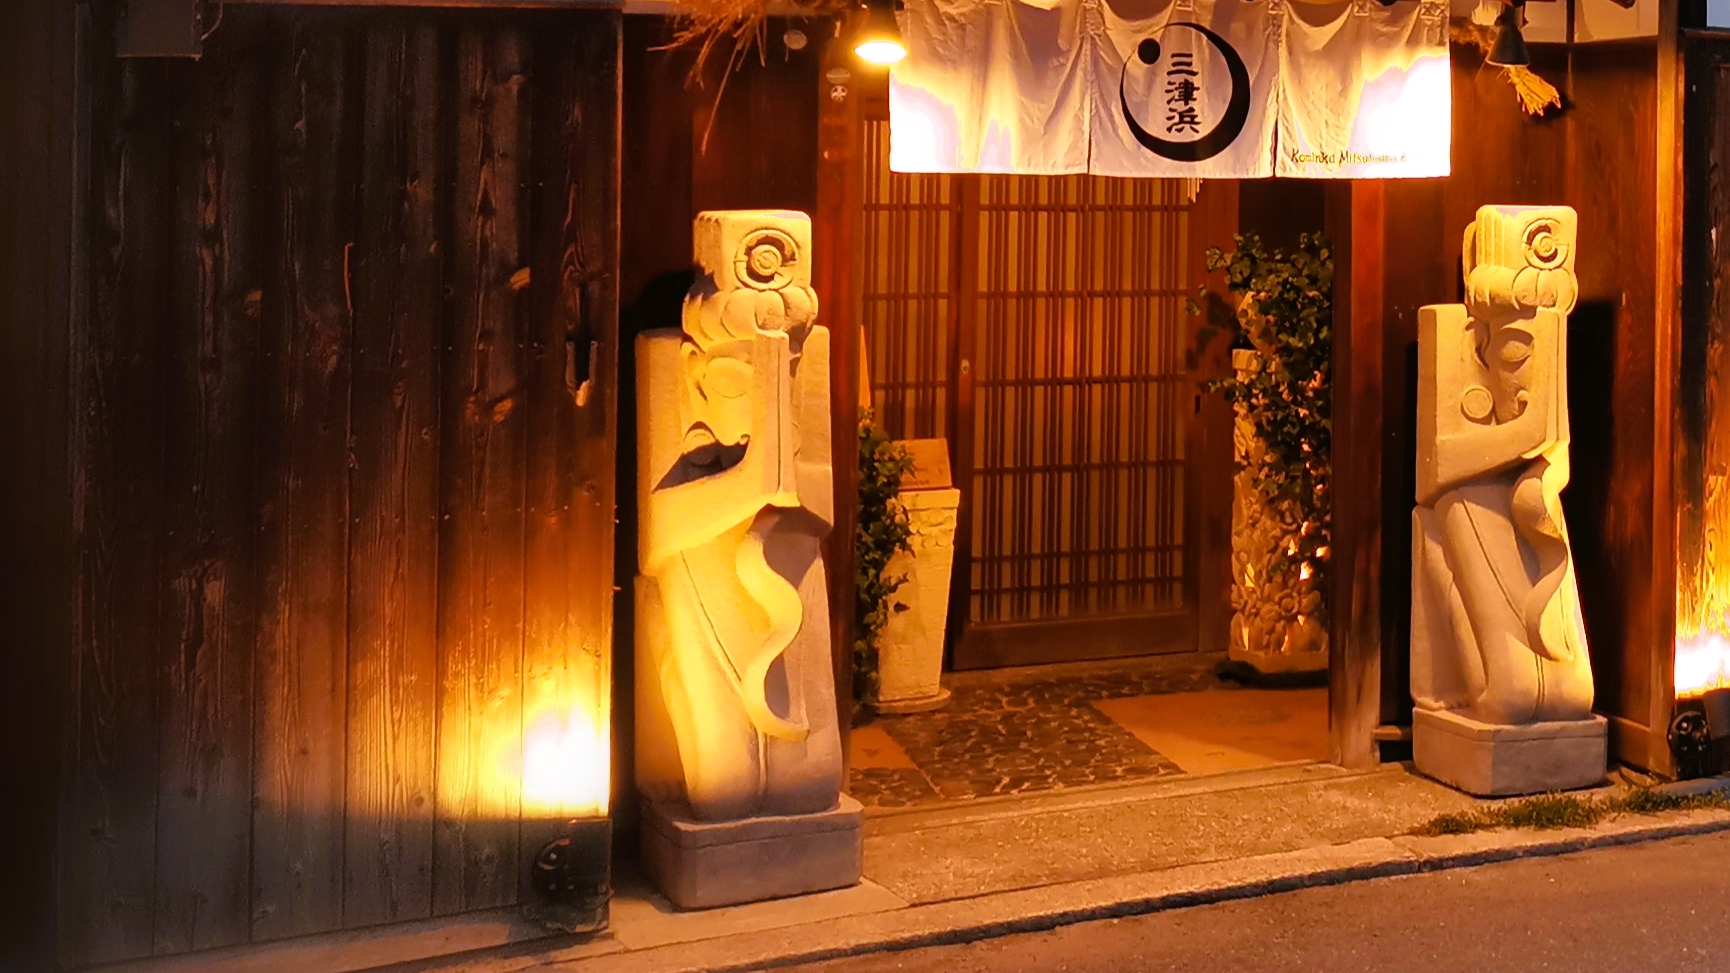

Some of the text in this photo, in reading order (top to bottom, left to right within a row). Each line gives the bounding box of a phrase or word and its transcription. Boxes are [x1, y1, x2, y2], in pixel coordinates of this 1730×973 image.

[1164, 52, 1202, 134] 三津浜
[1291, 148, 1335, 164] Kominka
